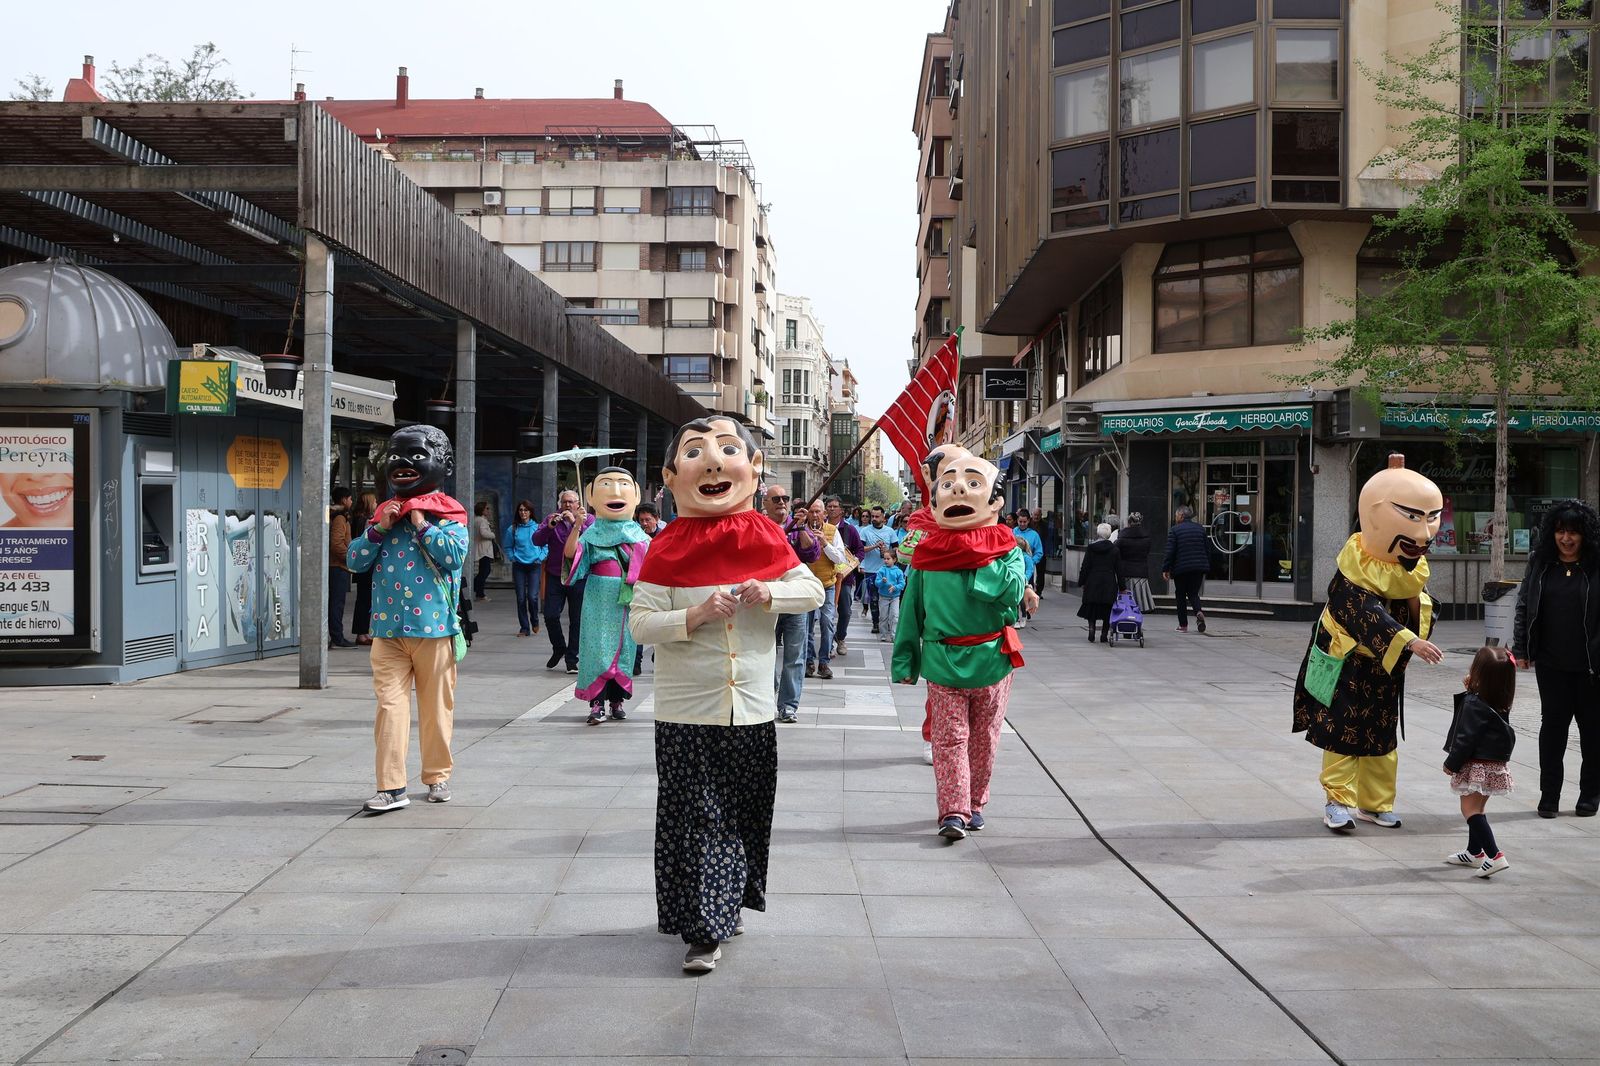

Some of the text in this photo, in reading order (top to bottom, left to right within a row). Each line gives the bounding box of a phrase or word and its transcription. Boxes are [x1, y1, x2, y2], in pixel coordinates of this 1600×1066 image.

[1103, 417, 1164, 429] HERBOLARIOS
[1240, 411, 1309, 424] HERBOLARIOS
[1531, 414, 1600, 426] HERBOLARIOS
[0, 447, 67, 468] Pereyra
[4, 547, 11, 555] 5
[12, 545, 38, 555] AÑOS
[11, 572, 25, 580] EN
[196, 523, 209, 638] RUTA
[273, 517, 283, 633] MURALES
[21, 581, 50, 592] 433
[30, 600, 50, 612] S/N
[14, 618, 27, 629] de
[29, 617, 61, 630] hierro)
